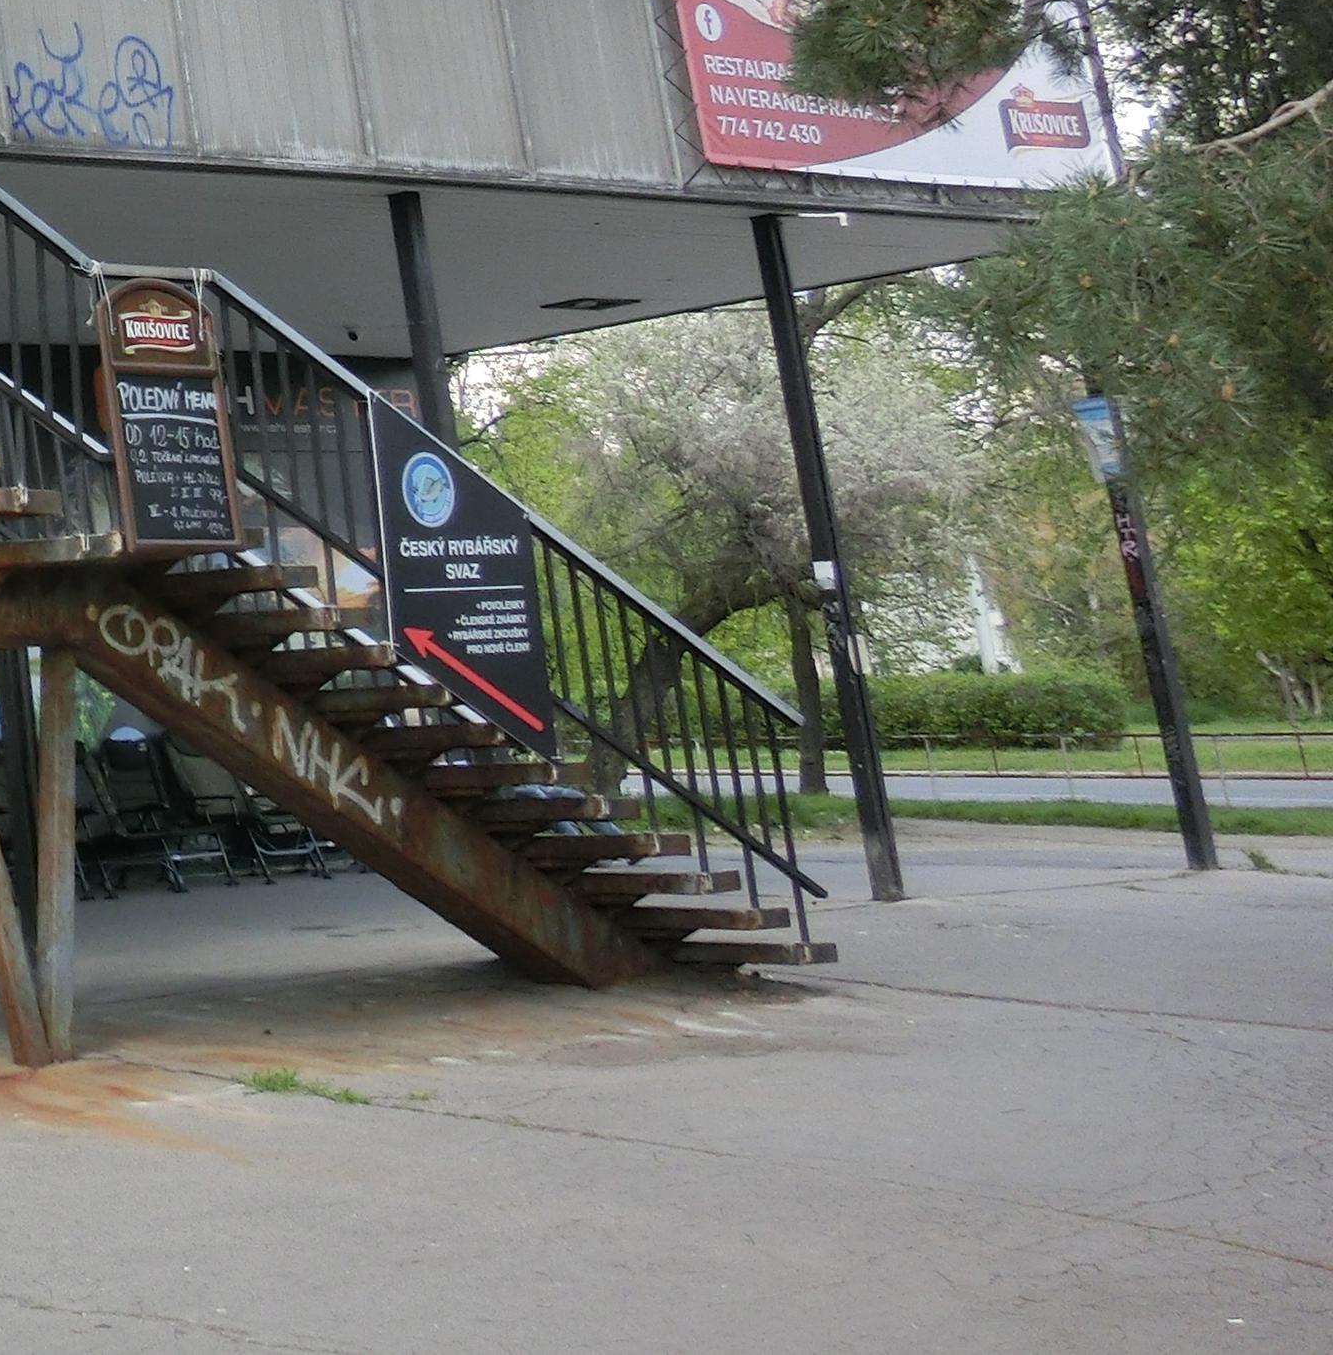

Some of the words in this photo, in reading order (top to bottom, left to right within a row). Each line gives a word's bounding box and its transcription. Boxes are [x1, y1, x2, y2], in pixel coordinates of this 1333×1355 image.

[717, 115, 749, 136] 774
[752, 120, 786, 141] 742
[789, 124, 822, 144] 430
[125, 319, 190, 340] KRUŠOVICE
[117, 381, 182, 411] POLEDNÍ
[125, 423, 142, 446] OD
[400, 537, 445, 557] ČESKÝ
[448, 535, 518, 556] RYBÁŘSKÝ
[445, 563, 481, 579] SVAZ
